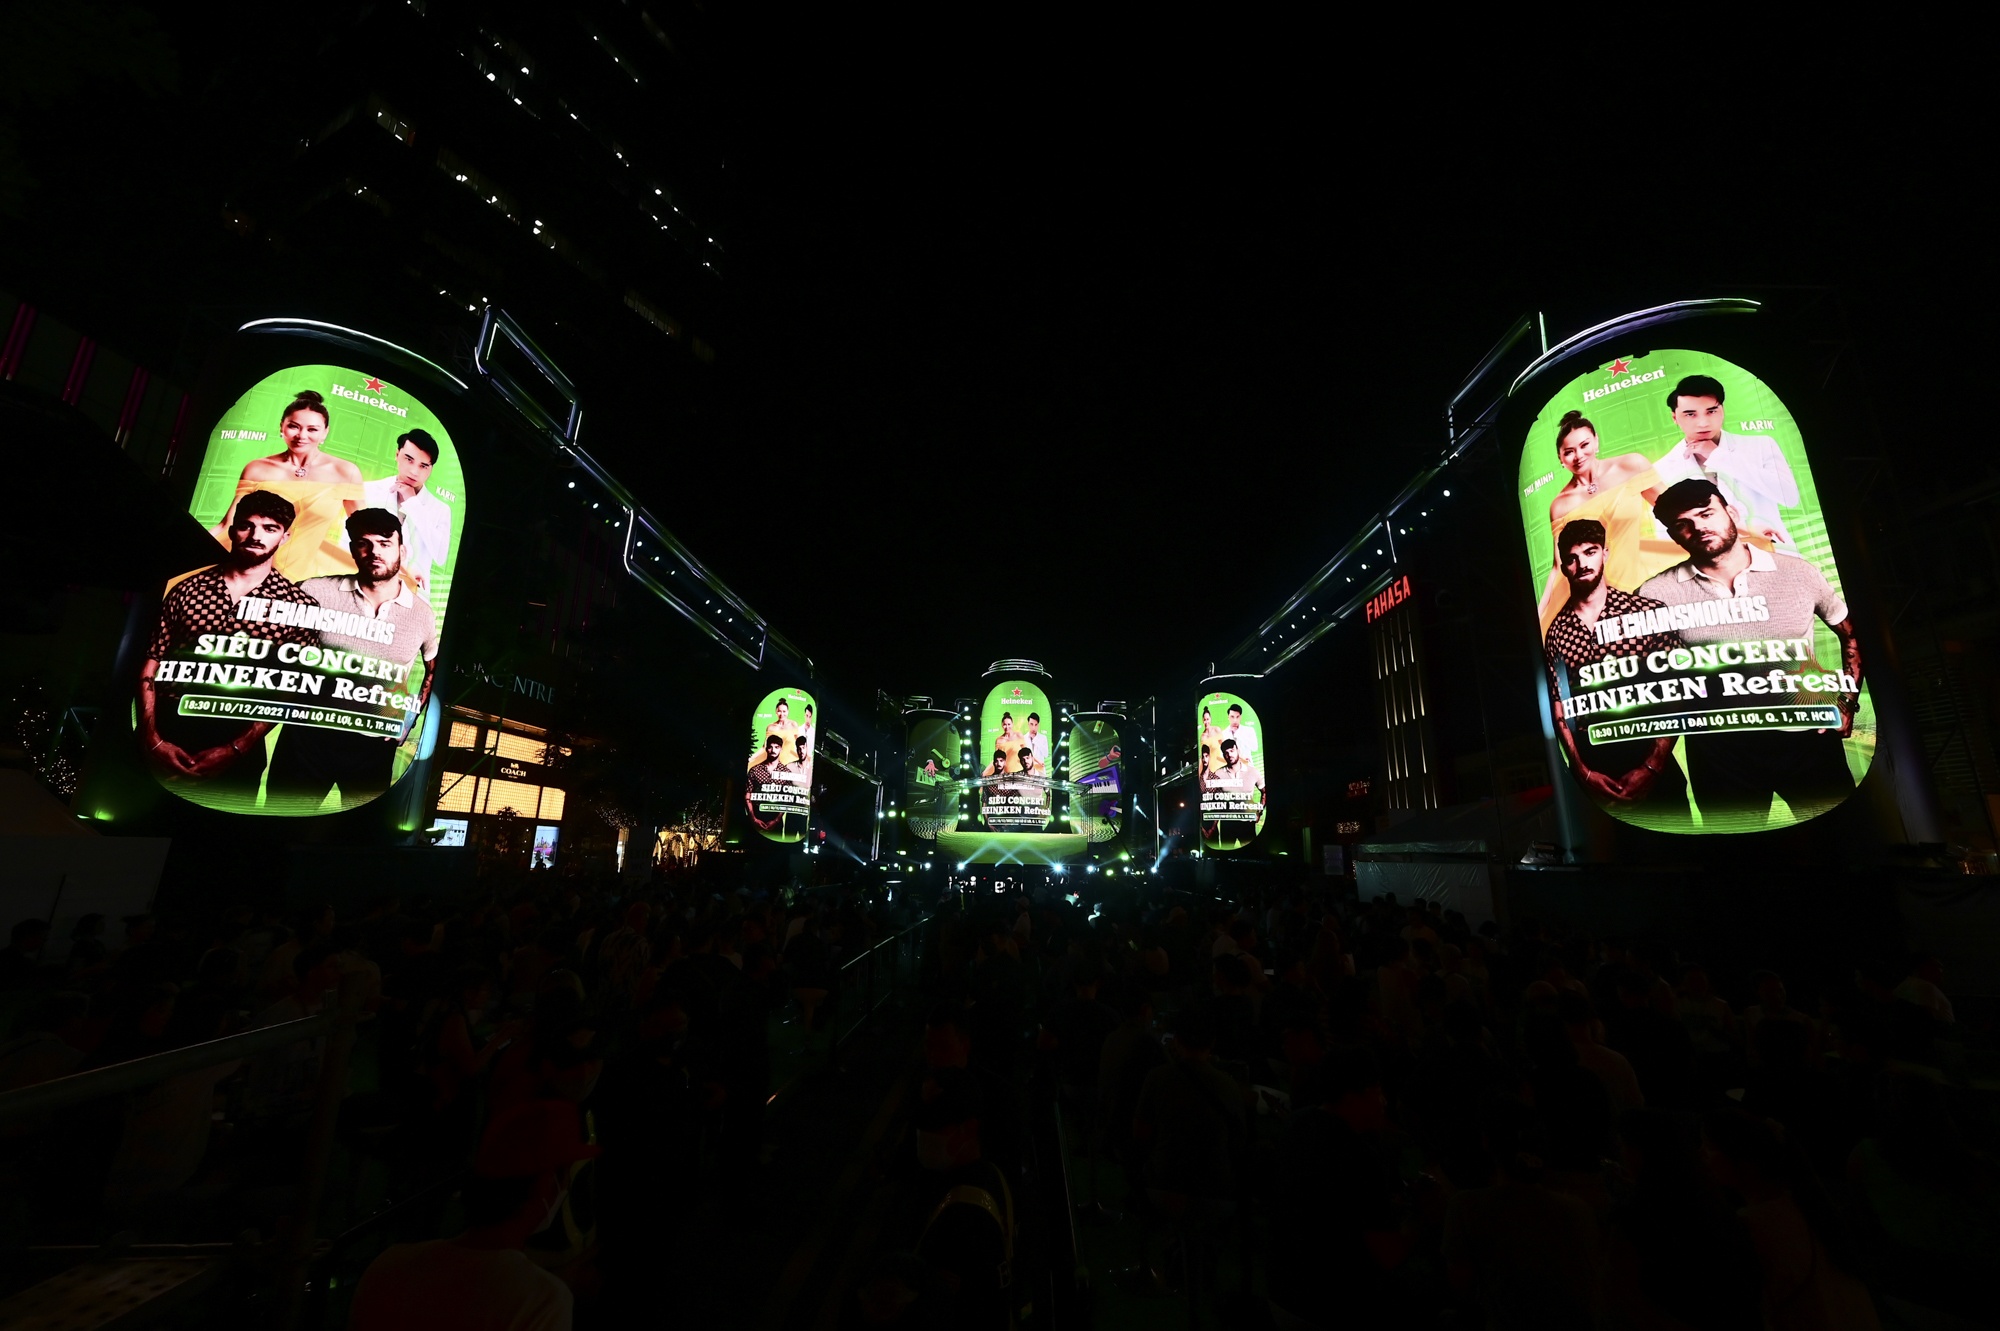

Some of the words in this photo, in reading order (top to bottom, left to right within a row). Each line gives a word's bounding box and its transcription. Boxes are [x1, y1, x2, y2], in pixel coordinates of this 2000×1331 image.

[331, 383, 408, 418] Heineken
[1582, 368, 1666, 403] Heineken
[221, 429, 237, 440] THU
[238, 429, 267, 441] MINH
[1740, 420, 1774, 431] KARIK
[435, 486, 456, 503] KARIK
[1535, 471, 1554, 490] MINH
[1366, 575, 1411, 624] FAHASA
[236, 596, 270, 622] THE
[268, 600, 395, 645] CHAINSMOKERS
[1594, 619, 1622, 645] THE
[1622, 595, 1770, 640] CHAINSMOKERS
[194, 631, 274, 660] SIÊU
[277, 643, 409, 684] CONCERT
[1578, 655, 1639, 688] SIÊU
[1646, 638, 1811, 674] CONCERT
[154, 660, 326, 696] HEINEKEN
[331, 676, 422, 714] Refresh
[1562, 675, 1708, 720] HEINEKEN
[1720, 669, 1859, 698] Refresh
[183, 699, 211, 711] 18:30
[219, 702, 283, 717] 10/12/2022
[310, 710, 324, 722] LỘ
[325, 711, 337, 723] LÊ
[375, 720, 385, 731] TP.
[385, 721, 401, 733] HCM
[1591, 726, 1613, 739] 18:30
[1619, 719, 1679, 735] 10/12/2022
[1709, 714, 1724, 728] LỘ
[1726, 713, 1740, 725] LÊ
[1794, 711, 1810, 722] TP.
[1811, 711, 1837, 722] HCM
[500, 766, 526, 777] COACH
[1007, 796, 1045, 806] CONCERT
[1023, 806, 1052, 816] Refresh
[1214, 792, 1252, 801] CONCERT
[1228, 801, 1264, 811] Refresh
